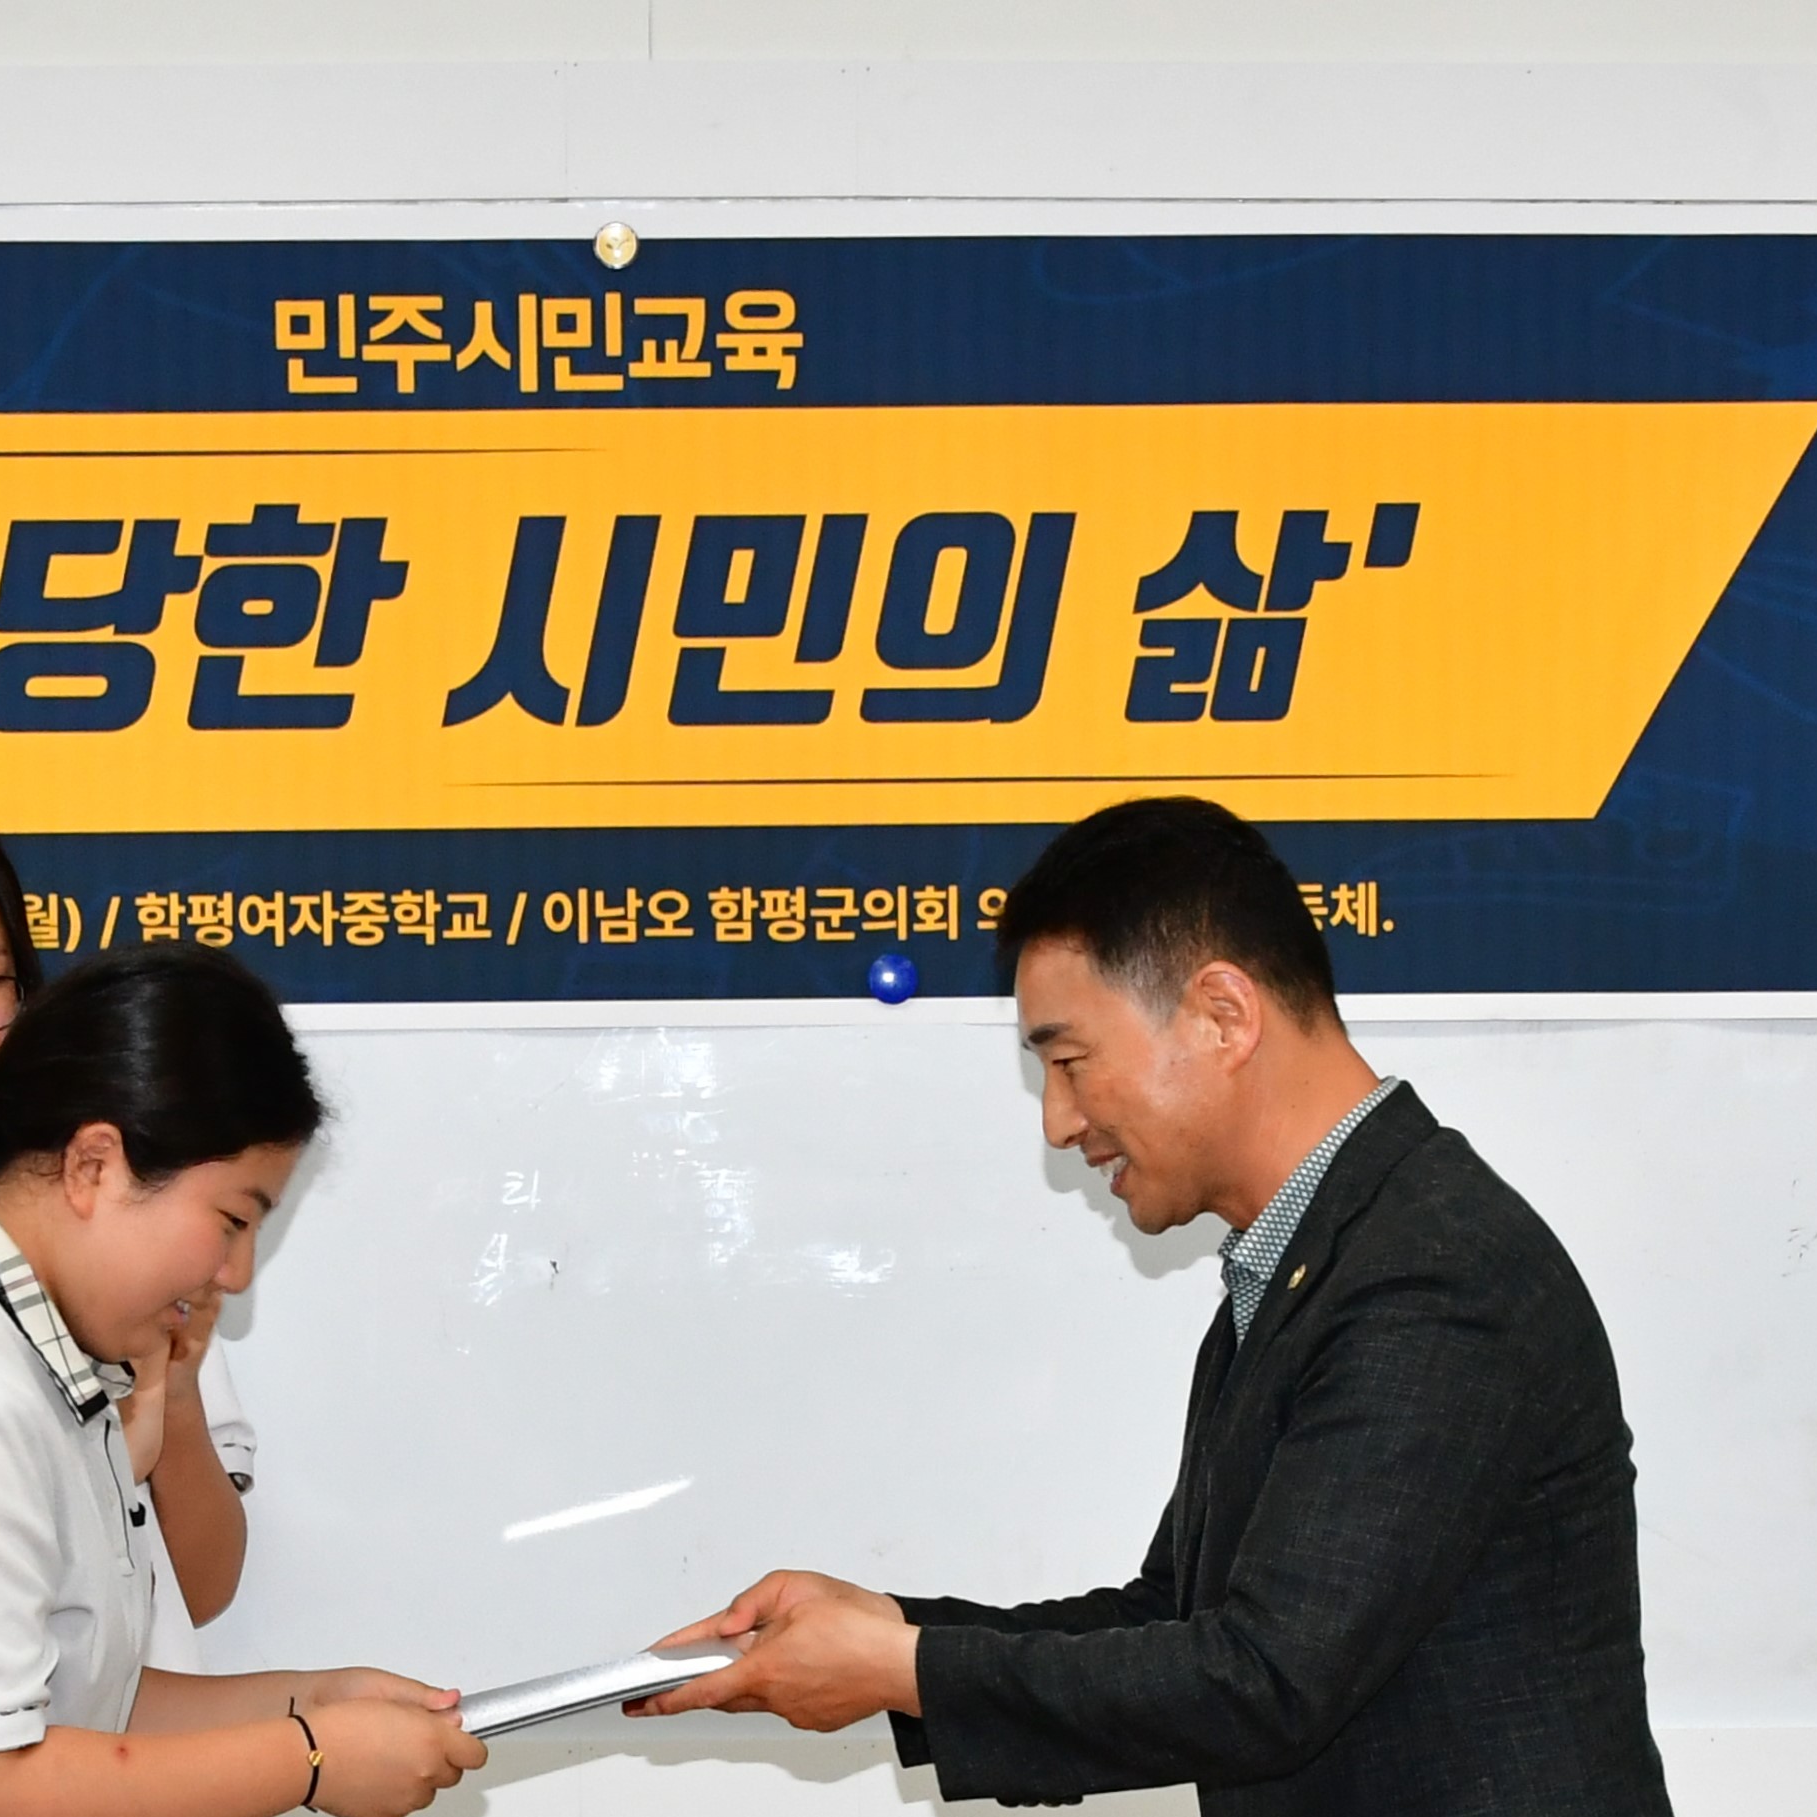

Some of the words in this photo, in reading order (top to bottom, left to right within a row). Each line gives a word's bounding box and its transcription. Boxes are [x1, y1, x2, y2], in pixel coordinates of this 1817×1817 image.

[274, 289, 805, 395] 민주시민교육
[441, 504, 1077, 728] 시민의
[1123, 501, 1422, 724] 삶'
[134, 889, 493, 948] 함평여자중학교
[542, 888, 695, 943] 이남오
[708, 885, 959, 942] 함평군의회
